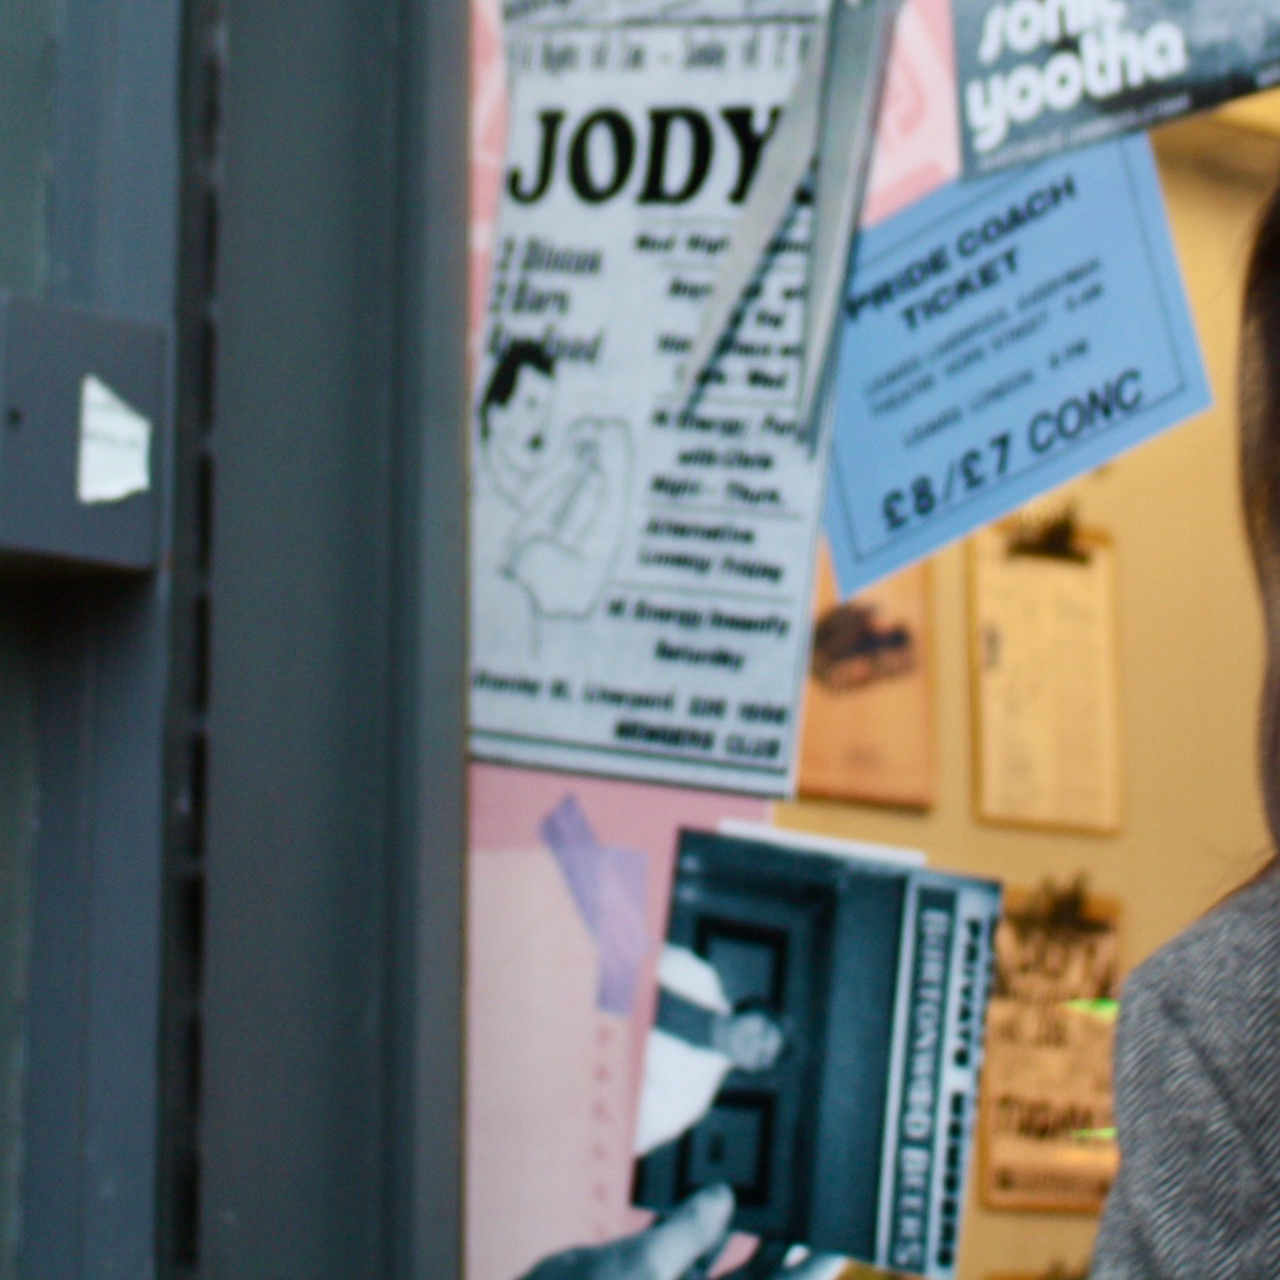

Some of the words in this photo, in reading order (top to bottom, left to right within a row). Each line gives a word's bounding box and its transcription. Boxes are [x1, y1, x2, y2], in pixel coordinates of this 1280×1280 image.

[964, 18, 1189, 154] yootha
[846, 245, 951, 322] PRIDE
[955, 173, 1077, 261] COACH
[900, 247, 1022, 334] TICKET
[880, 430, 1014, 534] £8/£7
[1027, 367, 1145, 457] CONC
[895, 1145, 929, 1268] BEERS
